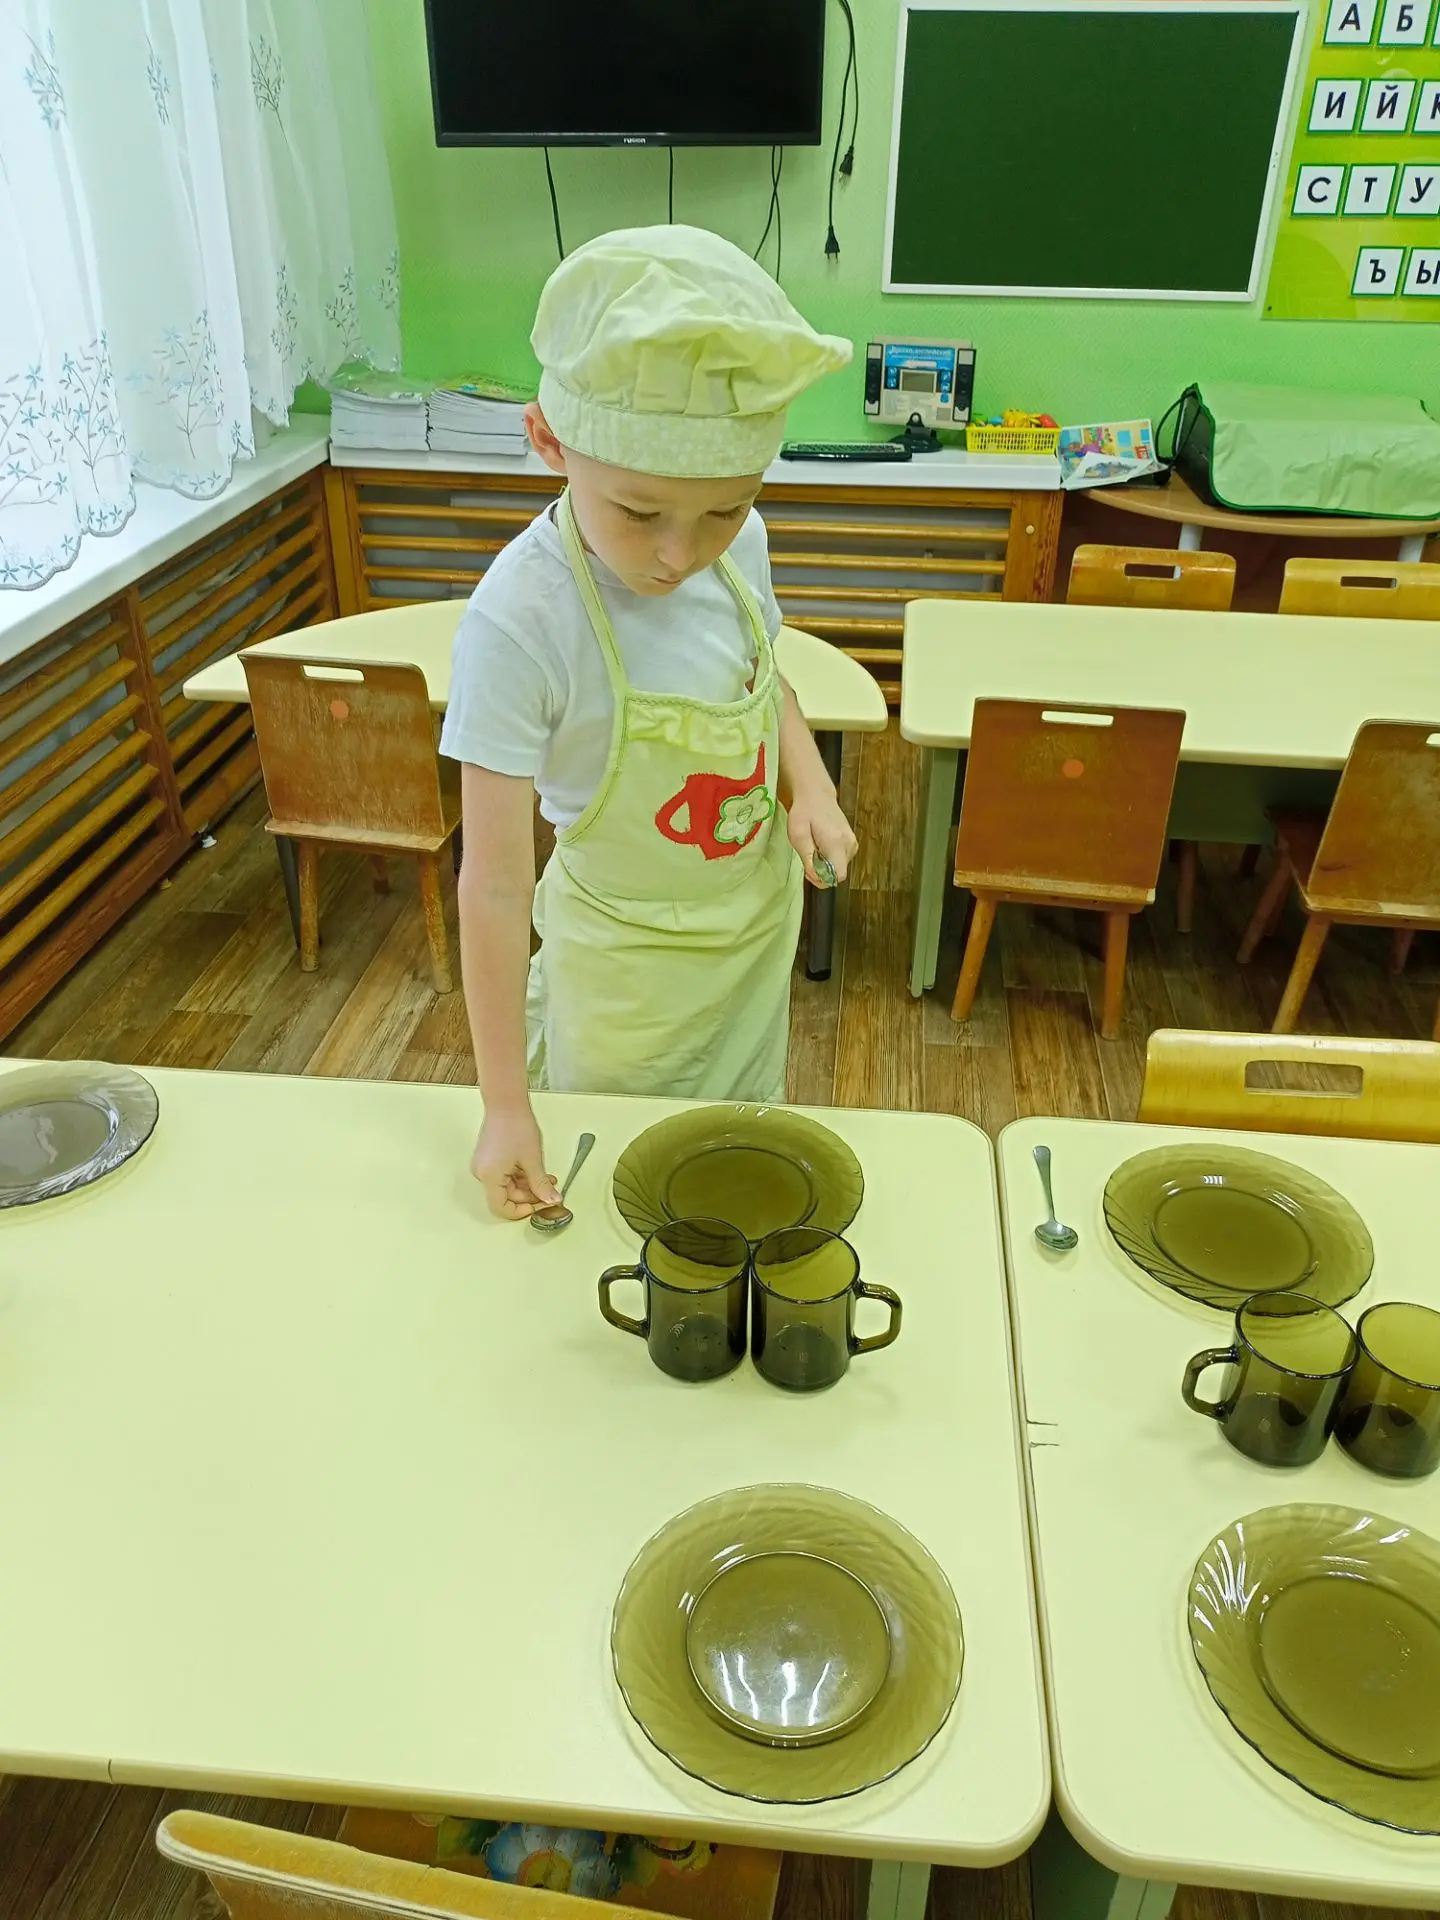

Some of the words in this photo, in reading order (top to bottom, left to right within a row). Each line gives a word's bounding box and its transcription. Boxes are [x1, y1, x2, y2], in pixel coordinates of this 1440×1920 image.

[1338, 3, 1361, 31] А
[1396, 4, 1414, 32] Б
[1324, 91, 1347, 119] И
[1376, 84, 1399, 119] Й
[1307, 176, 1332, 203] С
[1364, 177, 1378, 203] Т
[1409, 177, 1434, 203] У
[1369, 259, 1387, 284] Ъ
[1415, 260, 1440, 284] Ы
